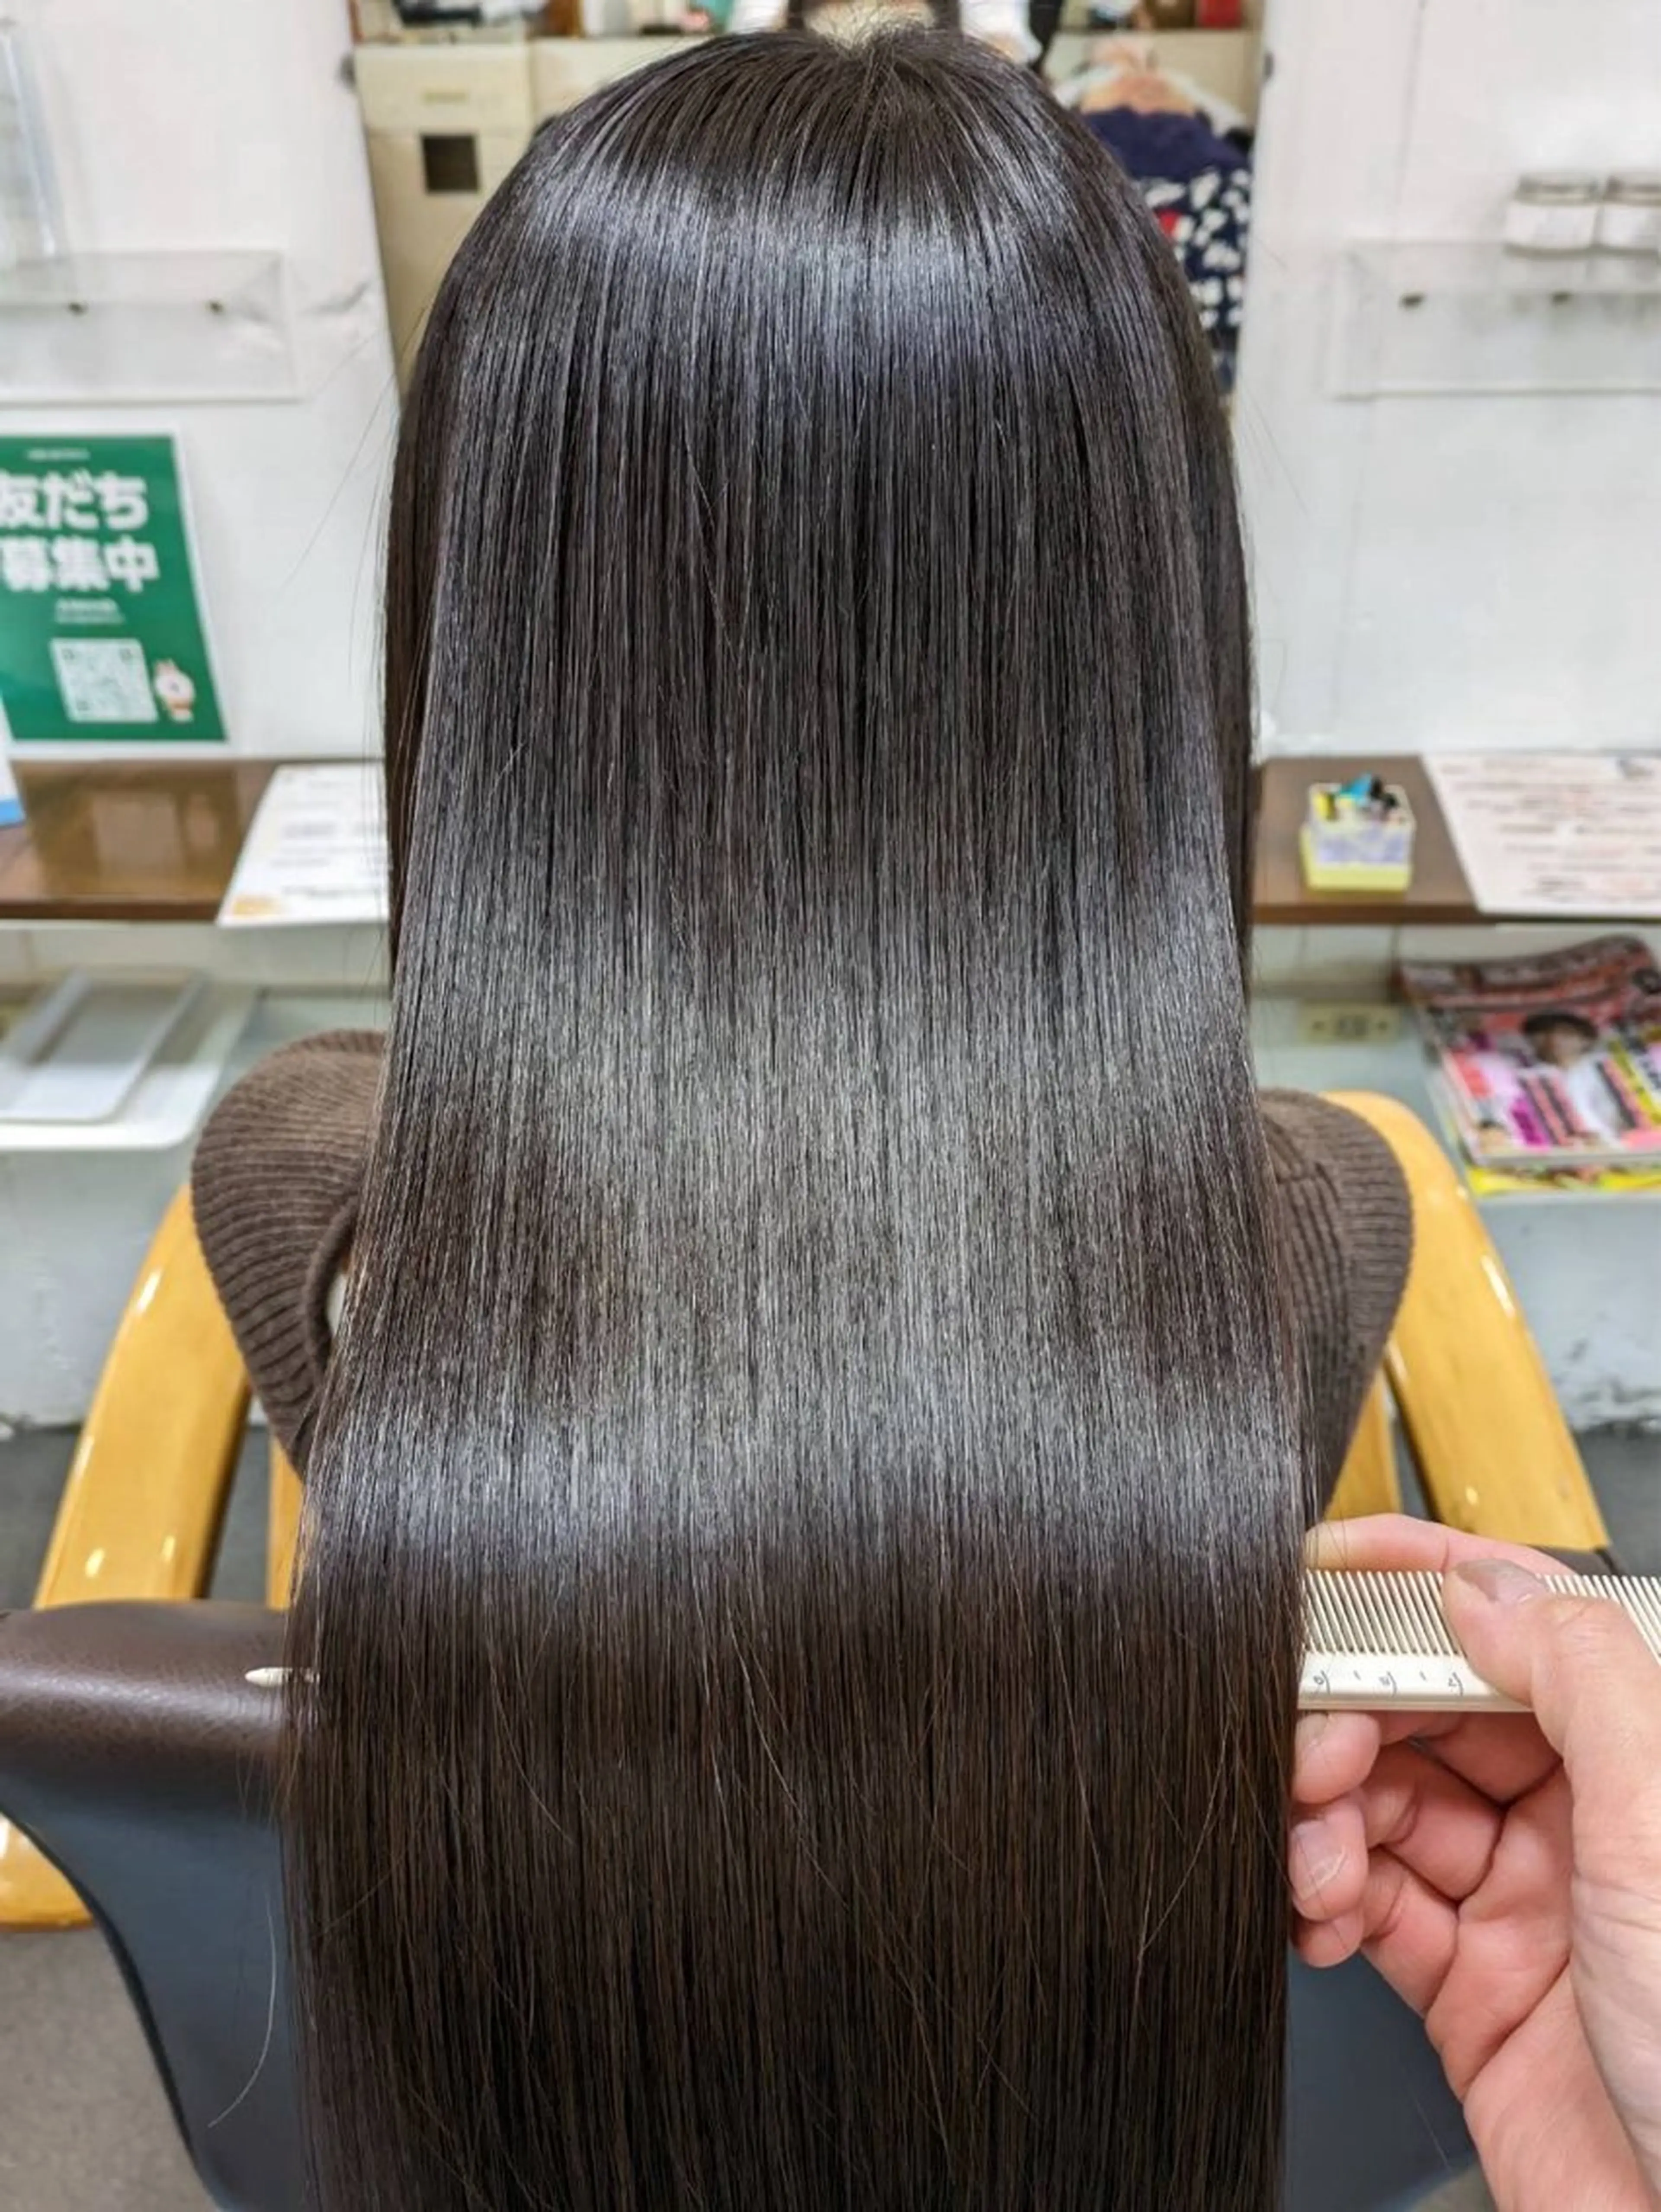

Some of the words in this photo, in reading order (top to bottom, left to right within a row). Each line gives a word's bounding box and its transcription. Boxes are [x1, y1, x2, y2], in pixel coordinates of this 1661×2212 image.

[0, 468, 148, 529] 友だち
[0, 536, 160, 592] 募集中
